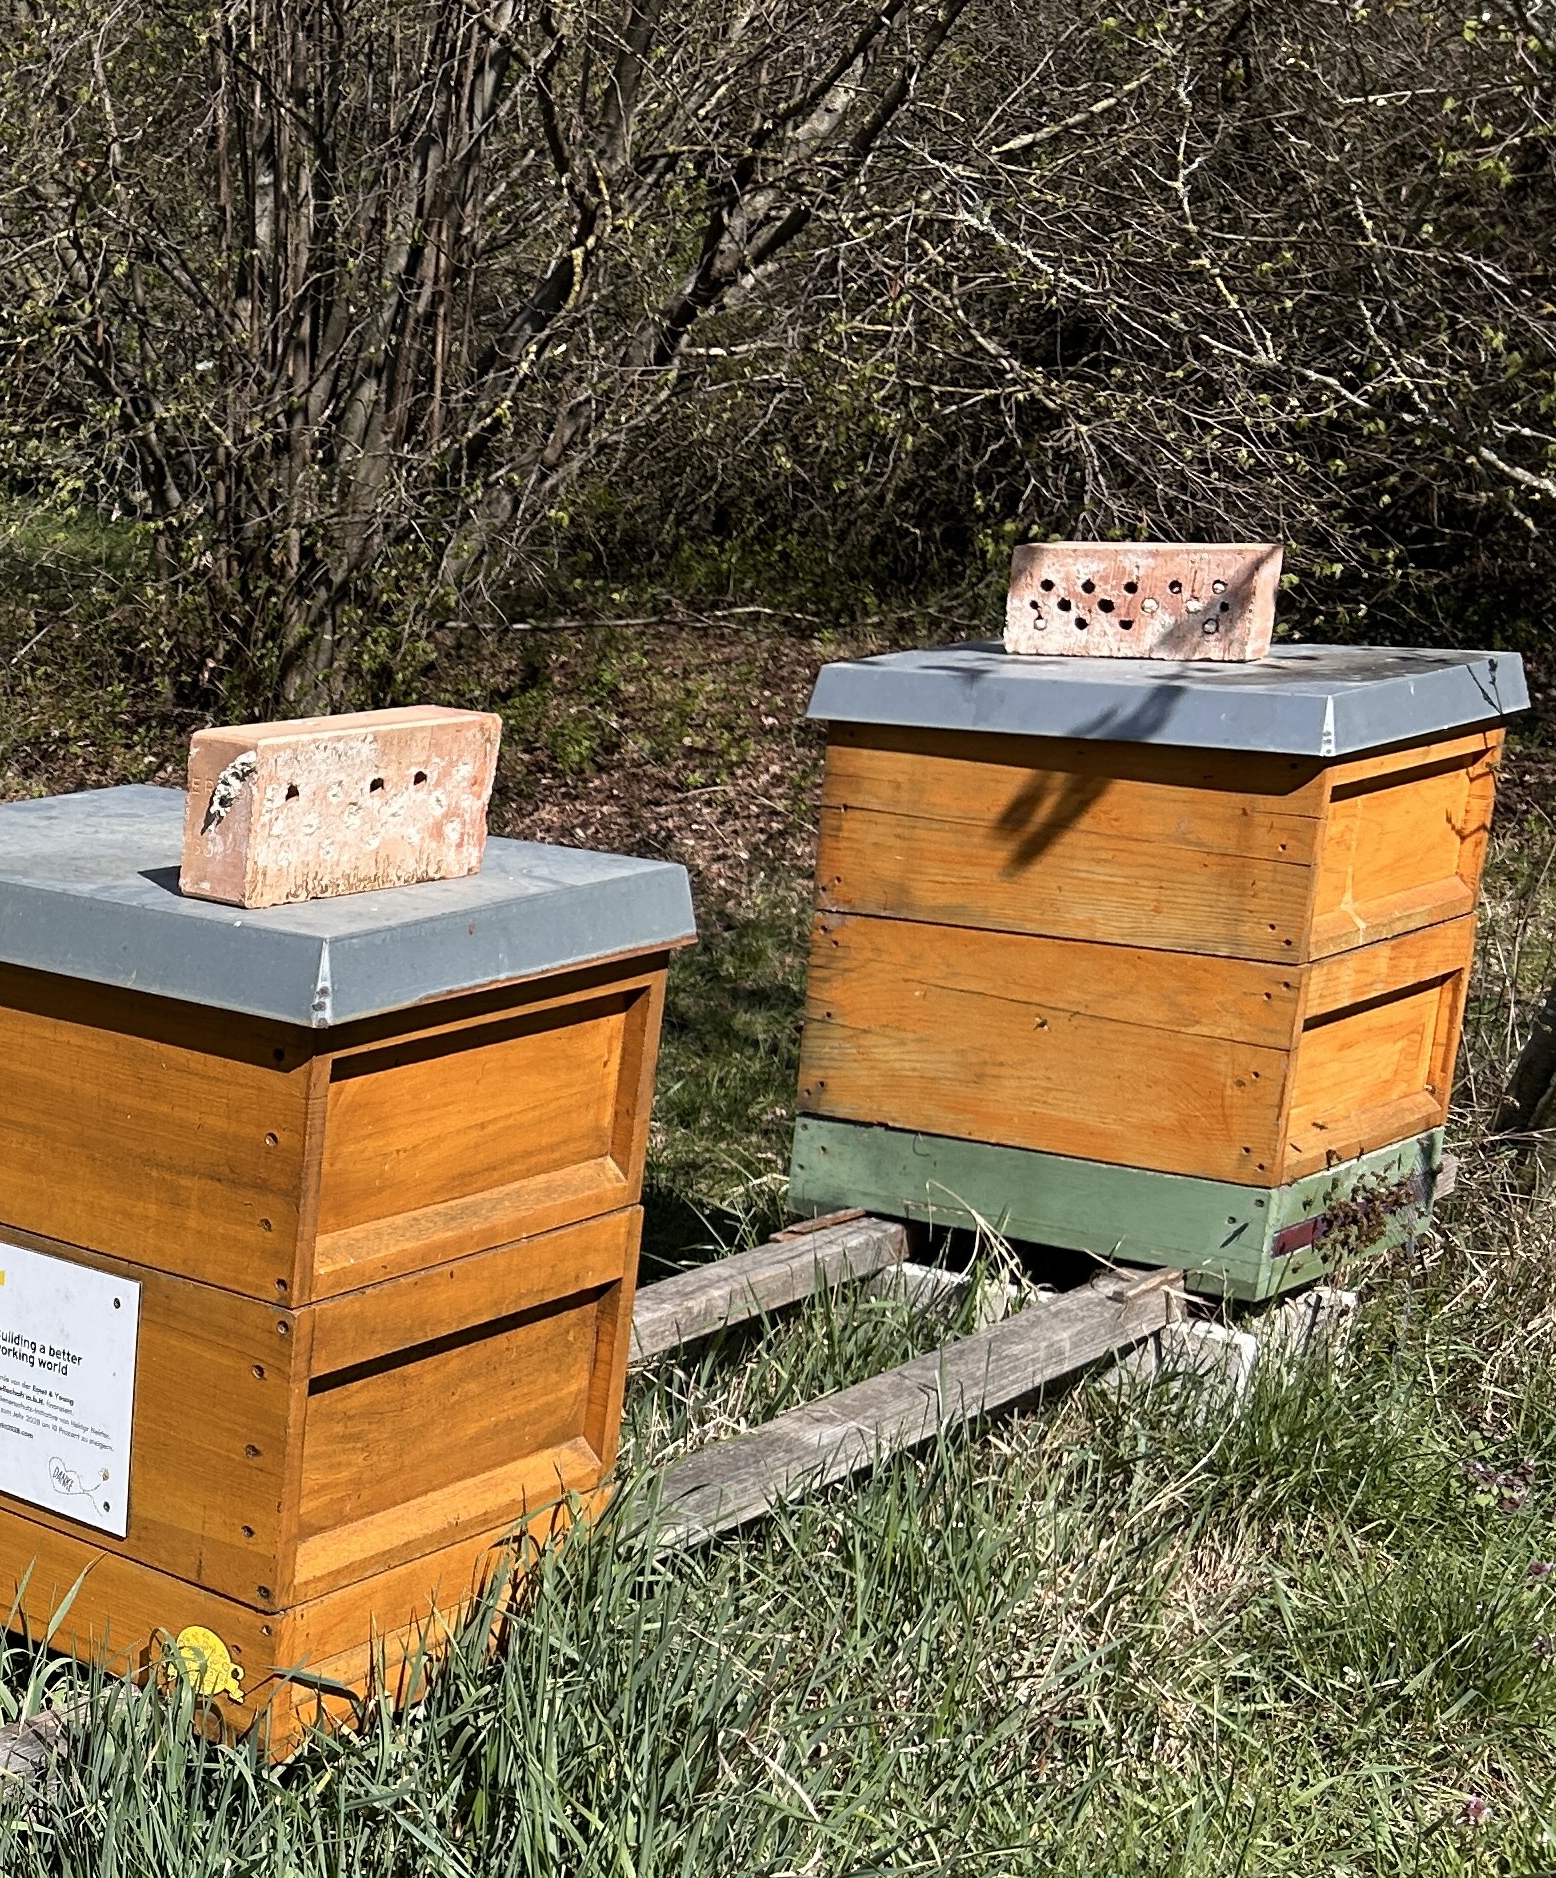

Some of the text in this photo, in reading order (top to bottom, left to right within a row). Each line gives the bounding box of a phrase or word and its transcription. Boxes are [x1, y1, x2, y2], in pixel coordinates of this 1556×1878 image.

[37, 1355, 68, 1376] world
[39, 1343, 46, 1354] a
[48, 1343, 82, 1367] better
[54, 1391, 74, 1407] Young
[52, 1466, 75, 1492] DANKE
